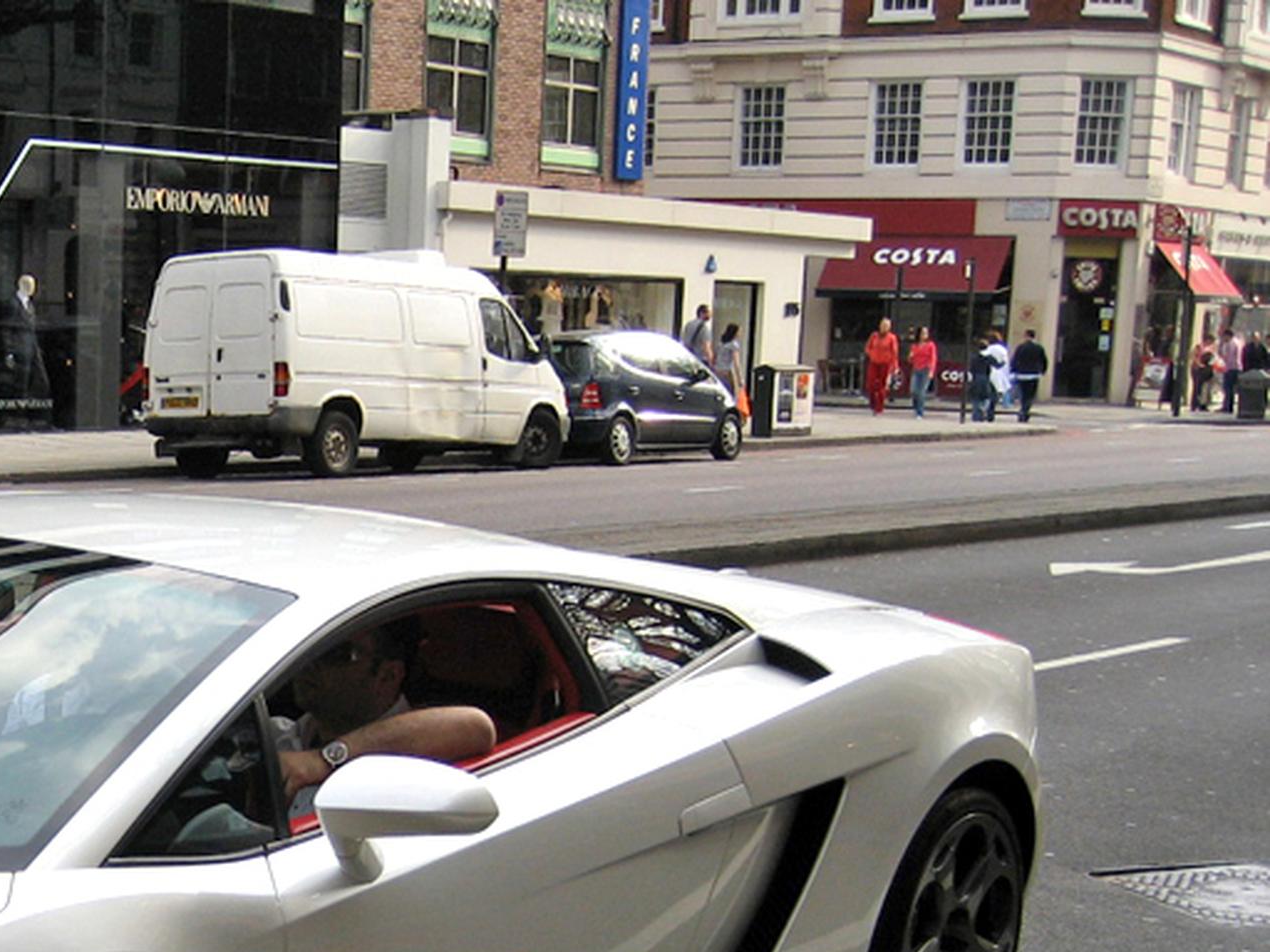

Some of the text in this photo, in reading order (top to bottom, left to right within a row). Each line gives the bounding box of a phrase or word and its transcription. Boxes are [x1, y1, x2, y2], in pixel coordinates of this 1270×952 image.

[625, 17, 641, 169] FRANCE
[126, 186, 270, 217] EMPORIO ARMANI
[1061, 206, 1138, 231] COSTA
[872, 247, 957, 267] COSTA
